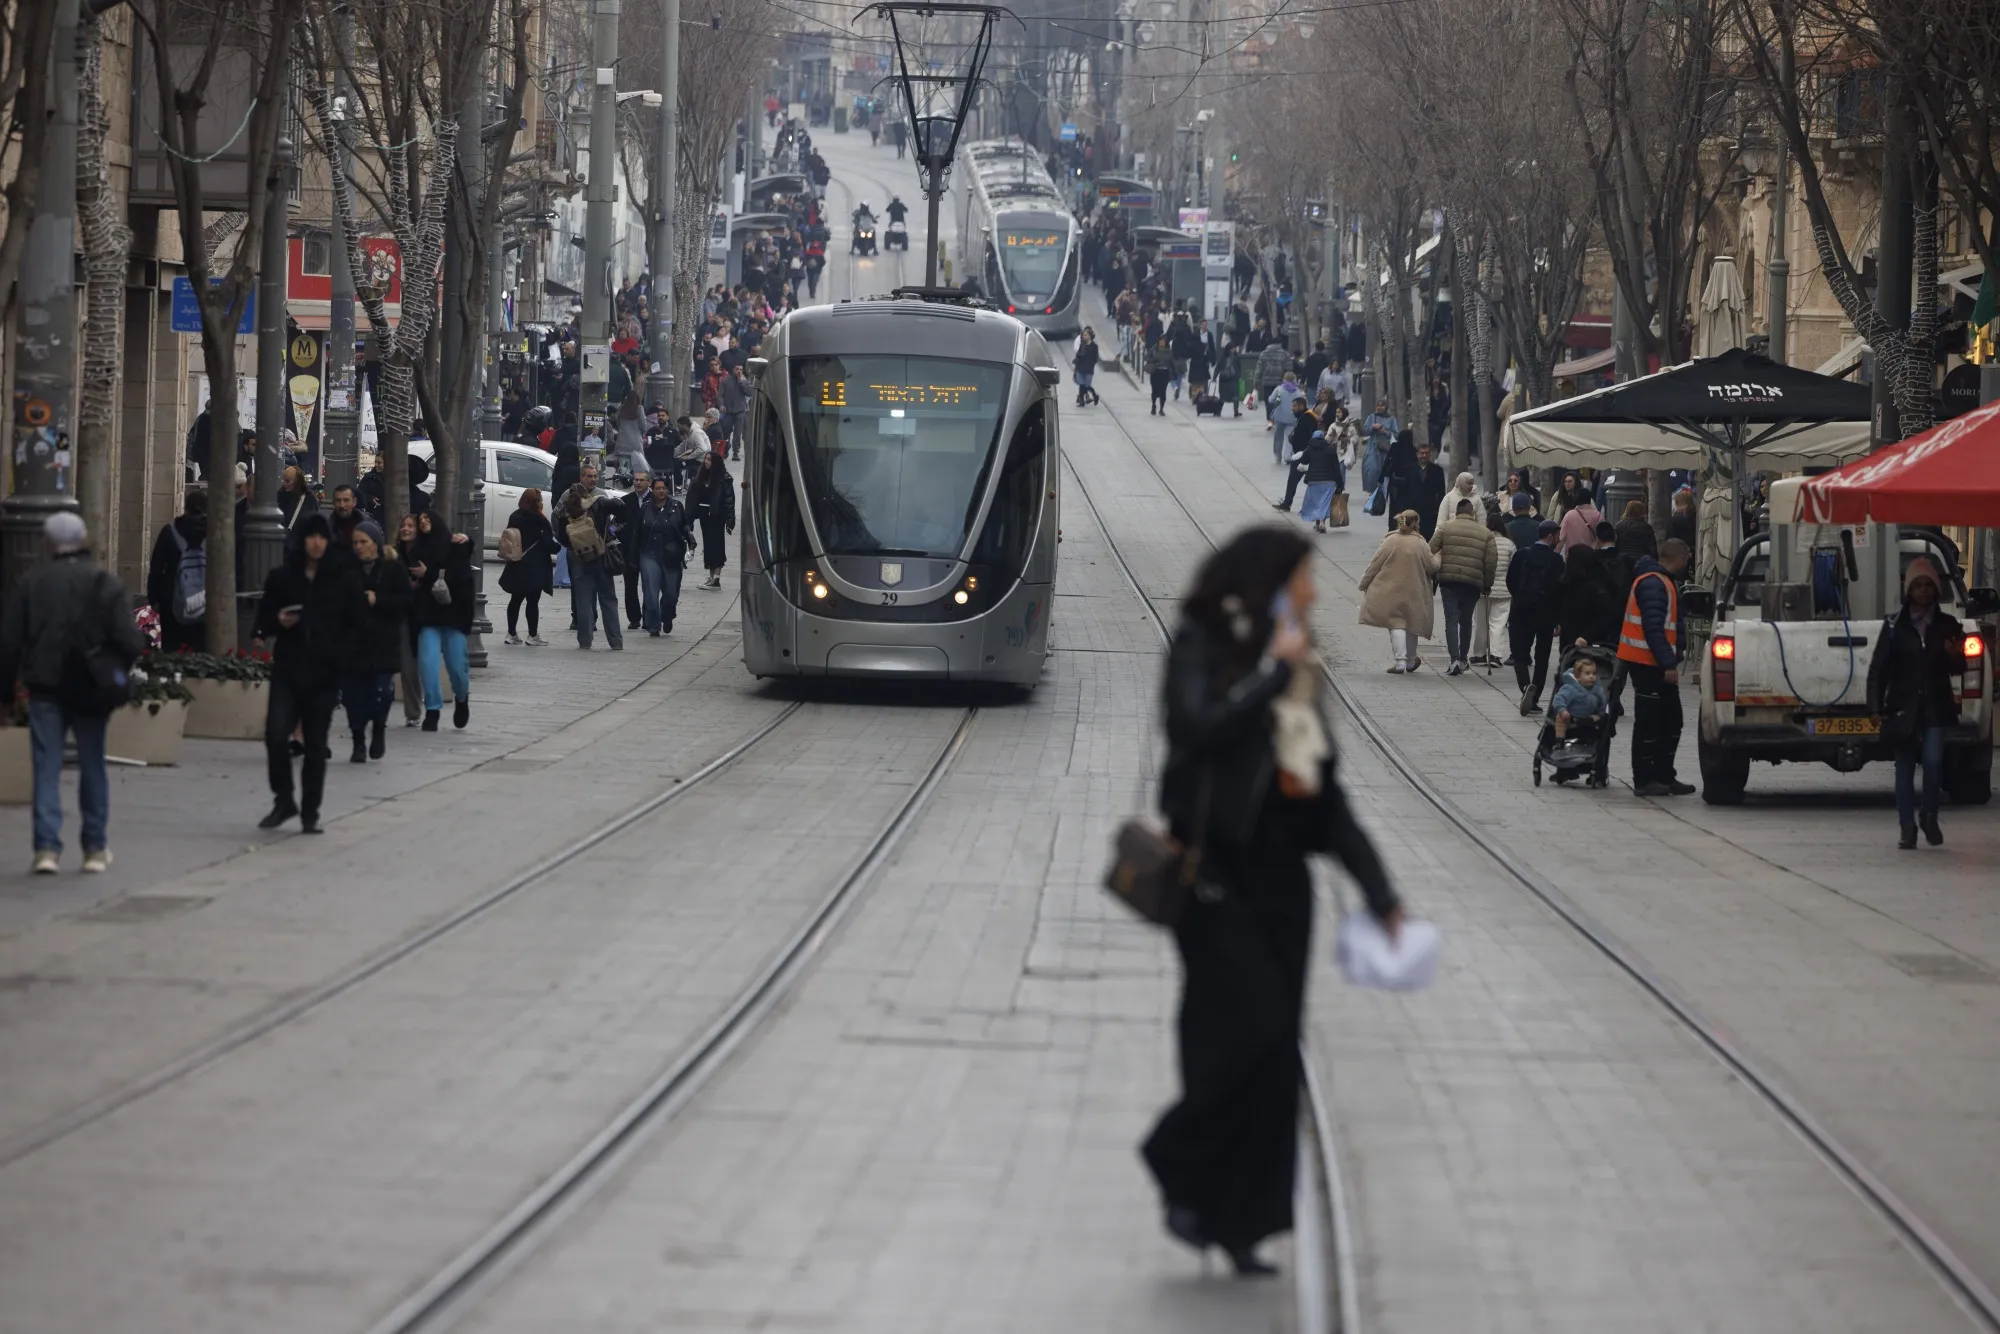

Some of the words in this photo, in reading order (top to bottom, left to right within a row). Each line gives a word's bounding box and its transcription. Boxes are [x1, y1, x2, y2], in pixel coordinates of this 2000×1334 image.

[297, 340, 312, 356] M
[1708, 383, 1784, 397] ארומה
[881, 592, 899, 606] 29
